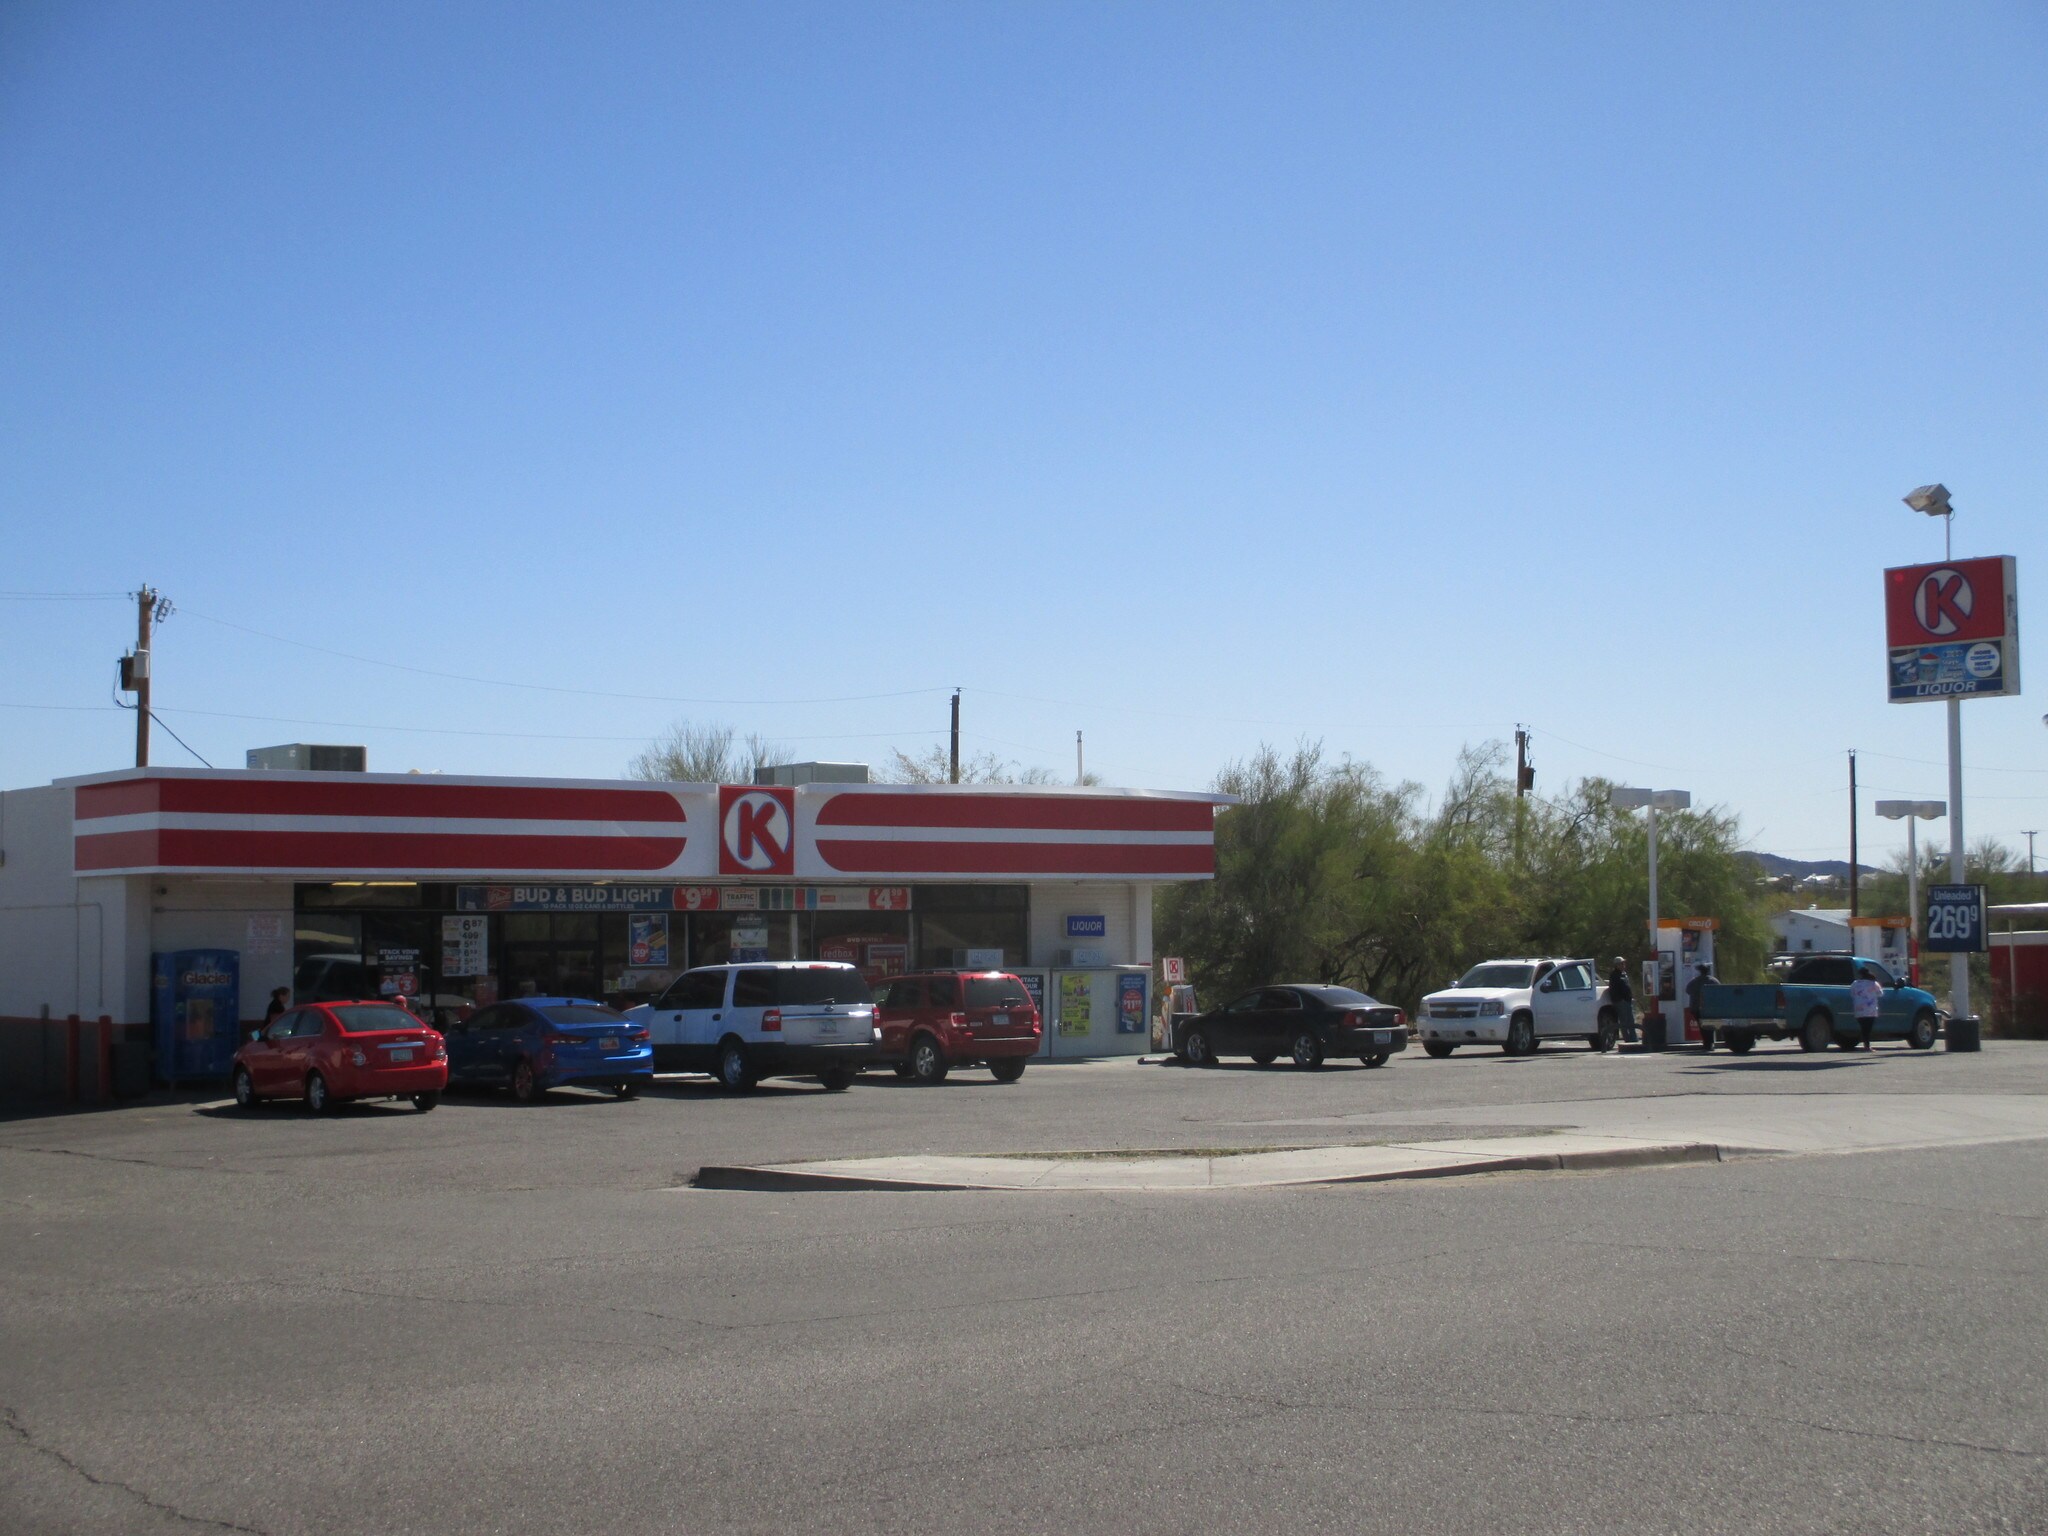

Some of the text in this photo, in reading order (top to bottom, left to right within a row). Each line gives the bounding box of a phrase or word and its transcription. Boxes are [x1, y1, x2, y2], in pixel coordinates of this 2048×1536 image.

[1924, 574, 1972, 630] K
[1916, 681, 1977, 696] LIQUOR
[738, 800, 789, 870] K
[514, 888, 663, 902] BUD & BUD LIGHT
[1933, 891, 1972, 901] Unleaded
[1072, 921, 1102, 931] LIQUOR
[823, 948, 853, 958] redbox
[184, 971, 232, 985] Glacier
